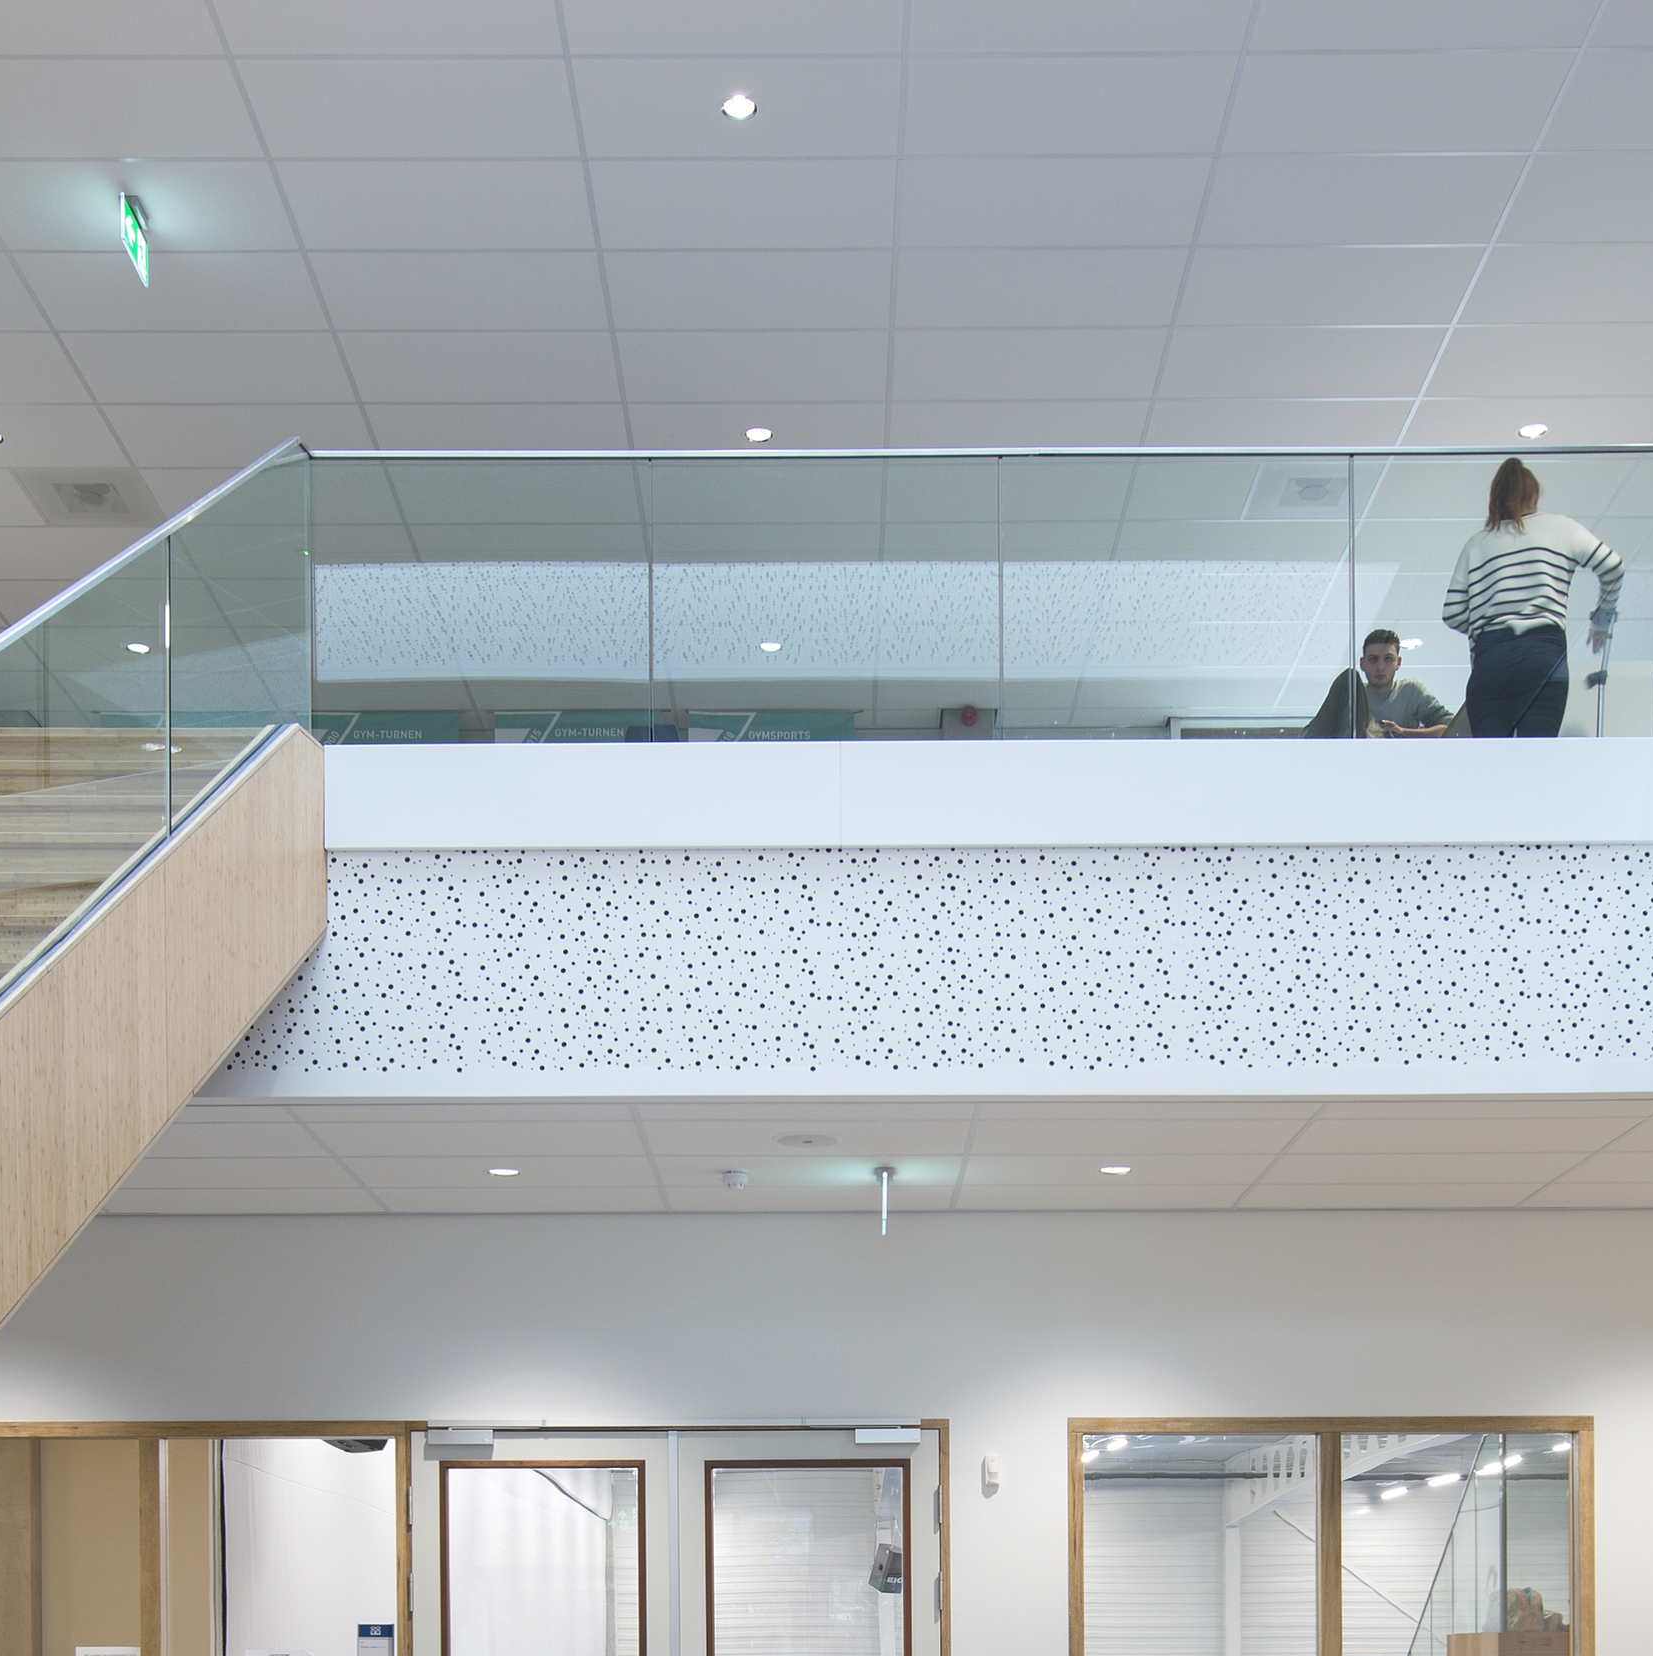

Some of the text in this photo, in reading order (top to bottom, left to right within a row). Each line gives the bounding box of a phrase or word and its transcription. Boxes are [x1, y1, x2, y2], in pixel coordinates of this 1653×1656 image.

[353, 730, 422, 739] GYM-TURNEN
[554, 728, 624, 737] GYM-TURNEN
[748, 731, 811, 740] GYMSPORTS
